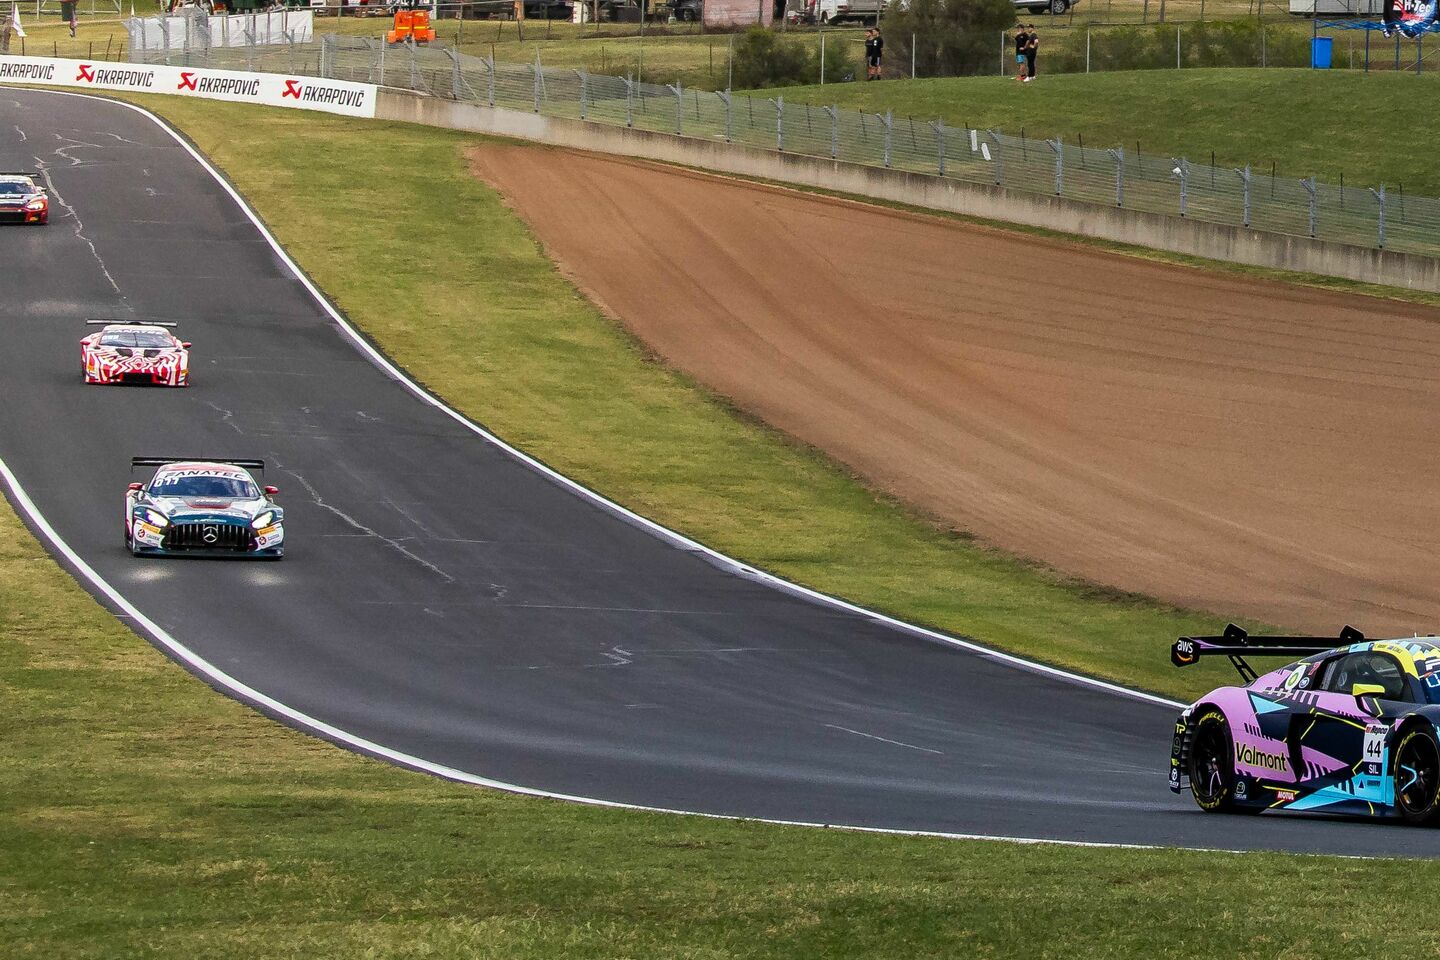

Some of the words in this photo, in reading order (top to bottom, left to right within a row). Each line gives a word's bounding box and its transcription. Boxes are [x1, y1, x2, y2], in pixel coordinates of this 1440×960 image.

[0, 63, 55, 80] AKRAPOVIČ
[96, 69, 155, 88] AKRAPOVIČ
[199, 77, 260, 96] AKRAPOVIČ
[303, 86, 365, 108] AKRAPOVIČ
[1177, 640, 1194, 654] aws
[1235, 742, 1287, 771] Valmont
[1366, 740, 1381, 758] 44
[1368, 764, 1379, 774] SIL
